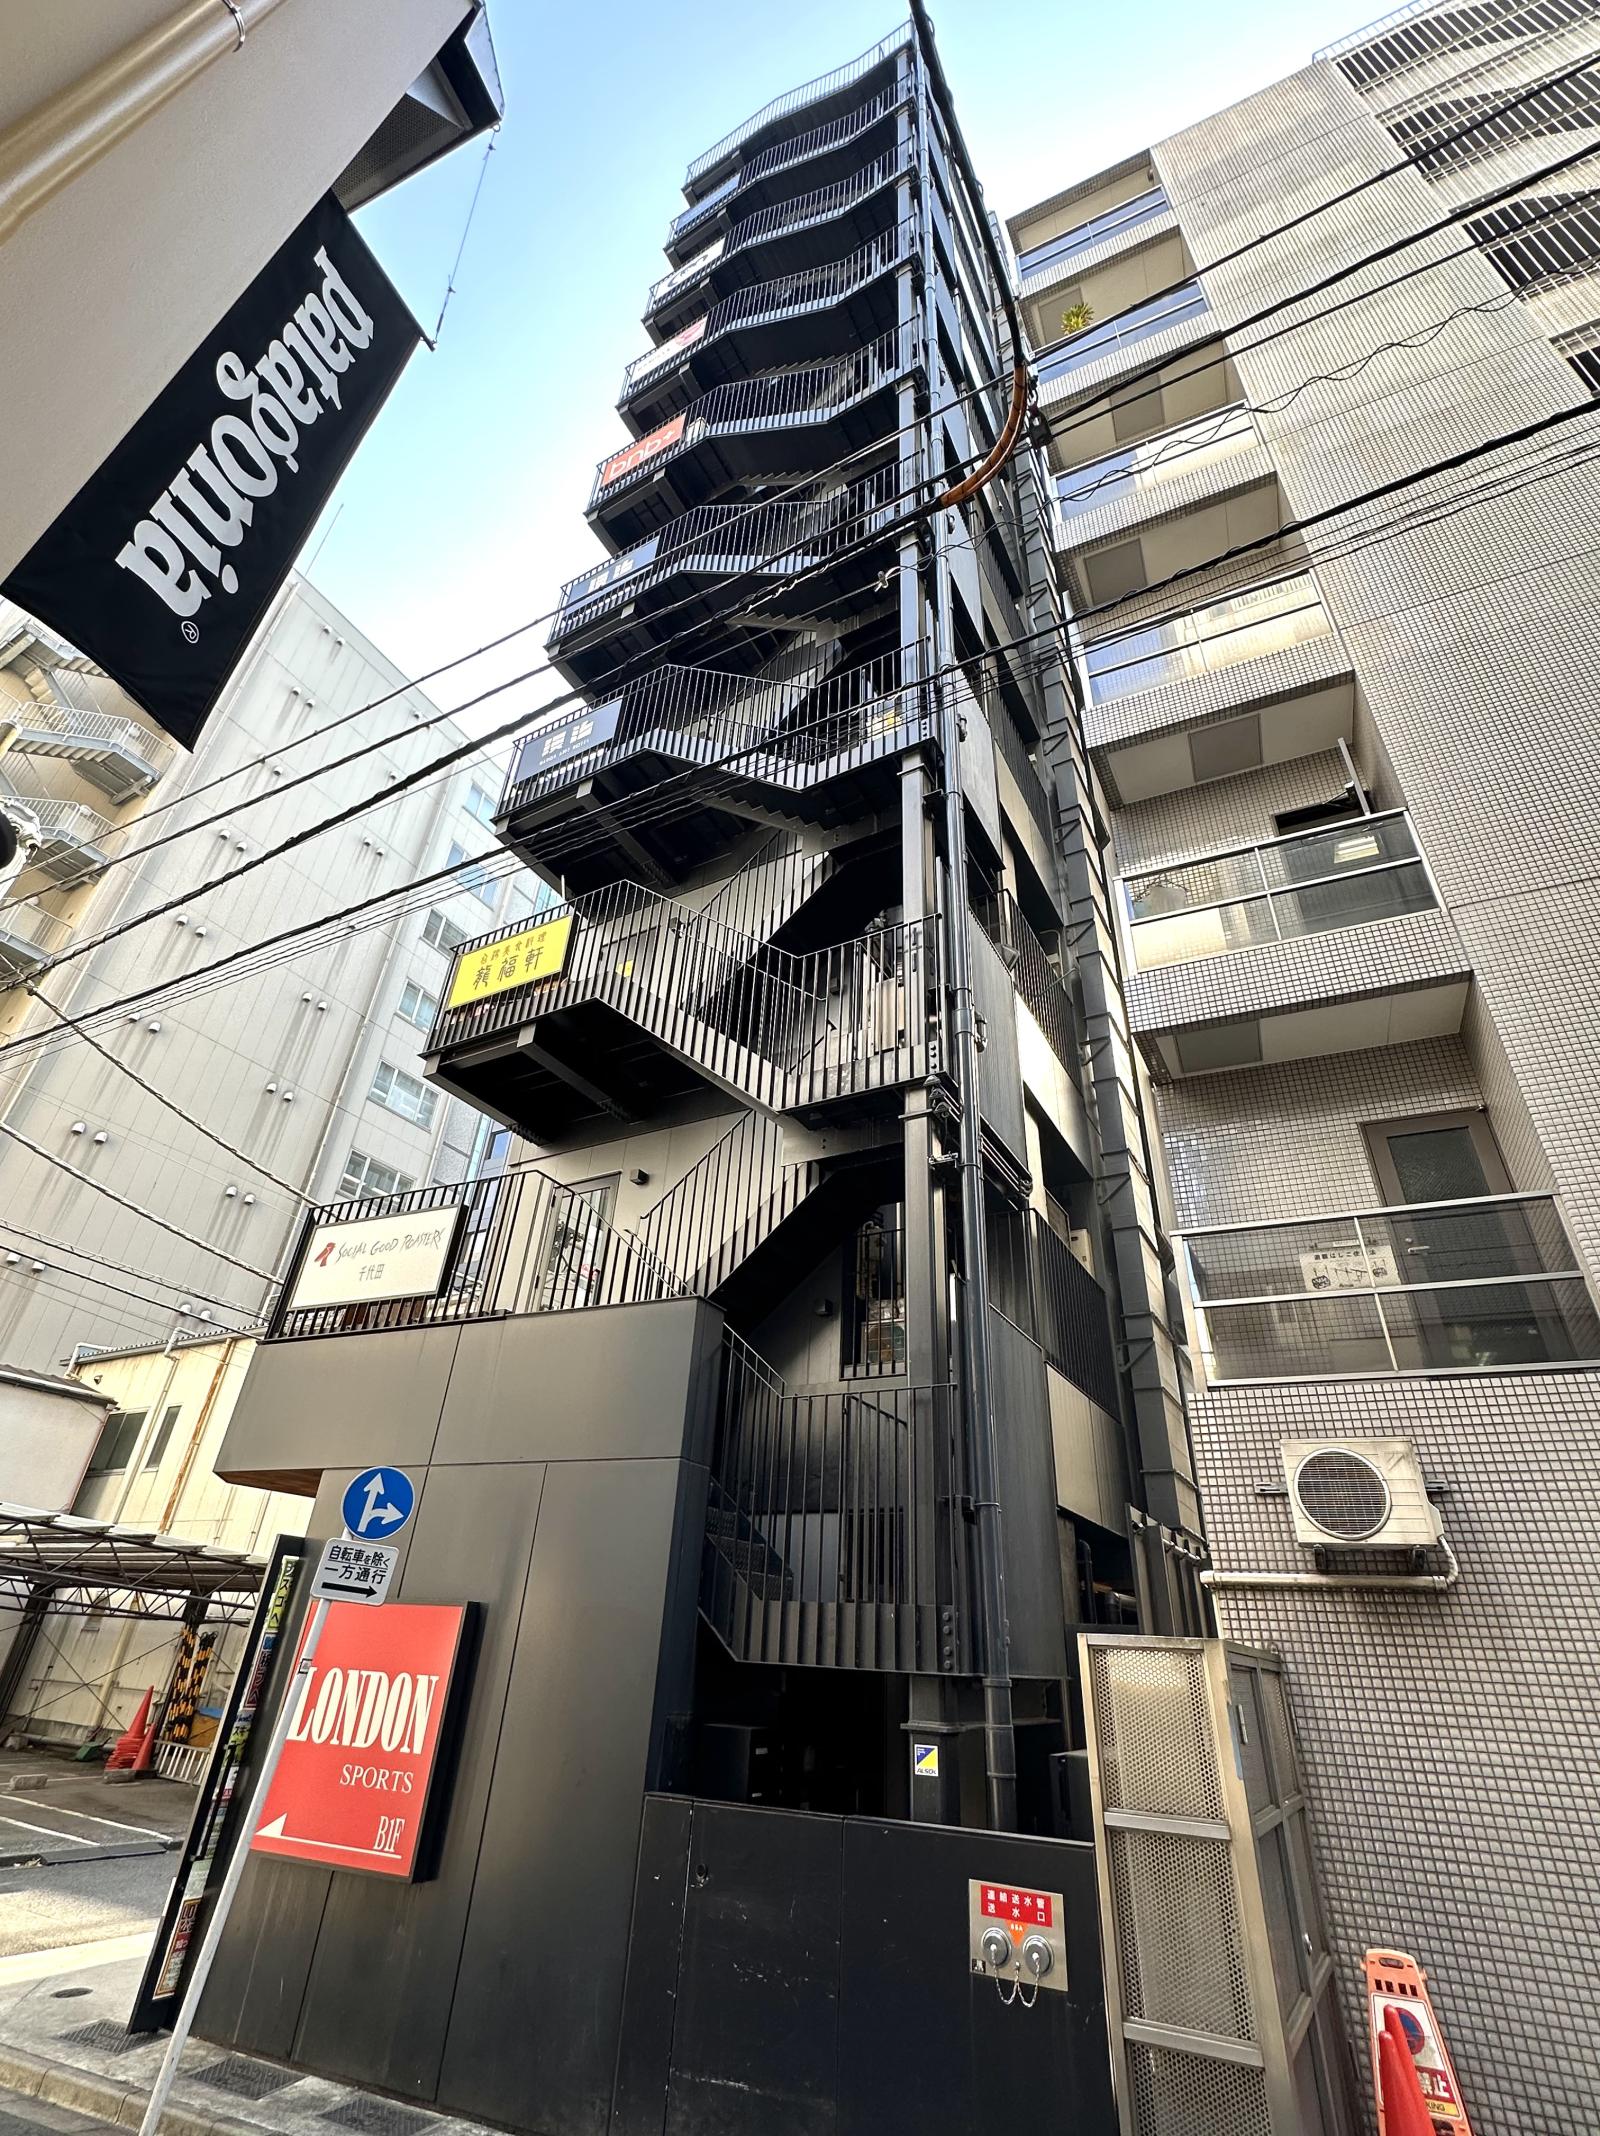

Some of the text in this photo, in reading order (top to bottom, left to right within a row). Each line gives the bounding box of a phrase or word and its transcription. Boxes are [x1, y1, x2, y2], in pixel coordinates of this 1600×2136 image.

[115, 245, 374, 617] patagonia
[336, 1227, 446, 1263] SOCIAL GOOD ROASTERS
[359, 1263, 385, 1281] 千代田
[329, 1545, 391, 1568] 自転車を除く
[324, 1564, 387, 1584] 一方通行
[286, 1667, 439, 1754] LONDON
[340, 1764, 414, 1793] SPORTS
[374, 1815, 405, 1852] B1F
[1417, 2072, 1451, 2098] 禁止
[1426, 2101, 1445, 2111] KING
